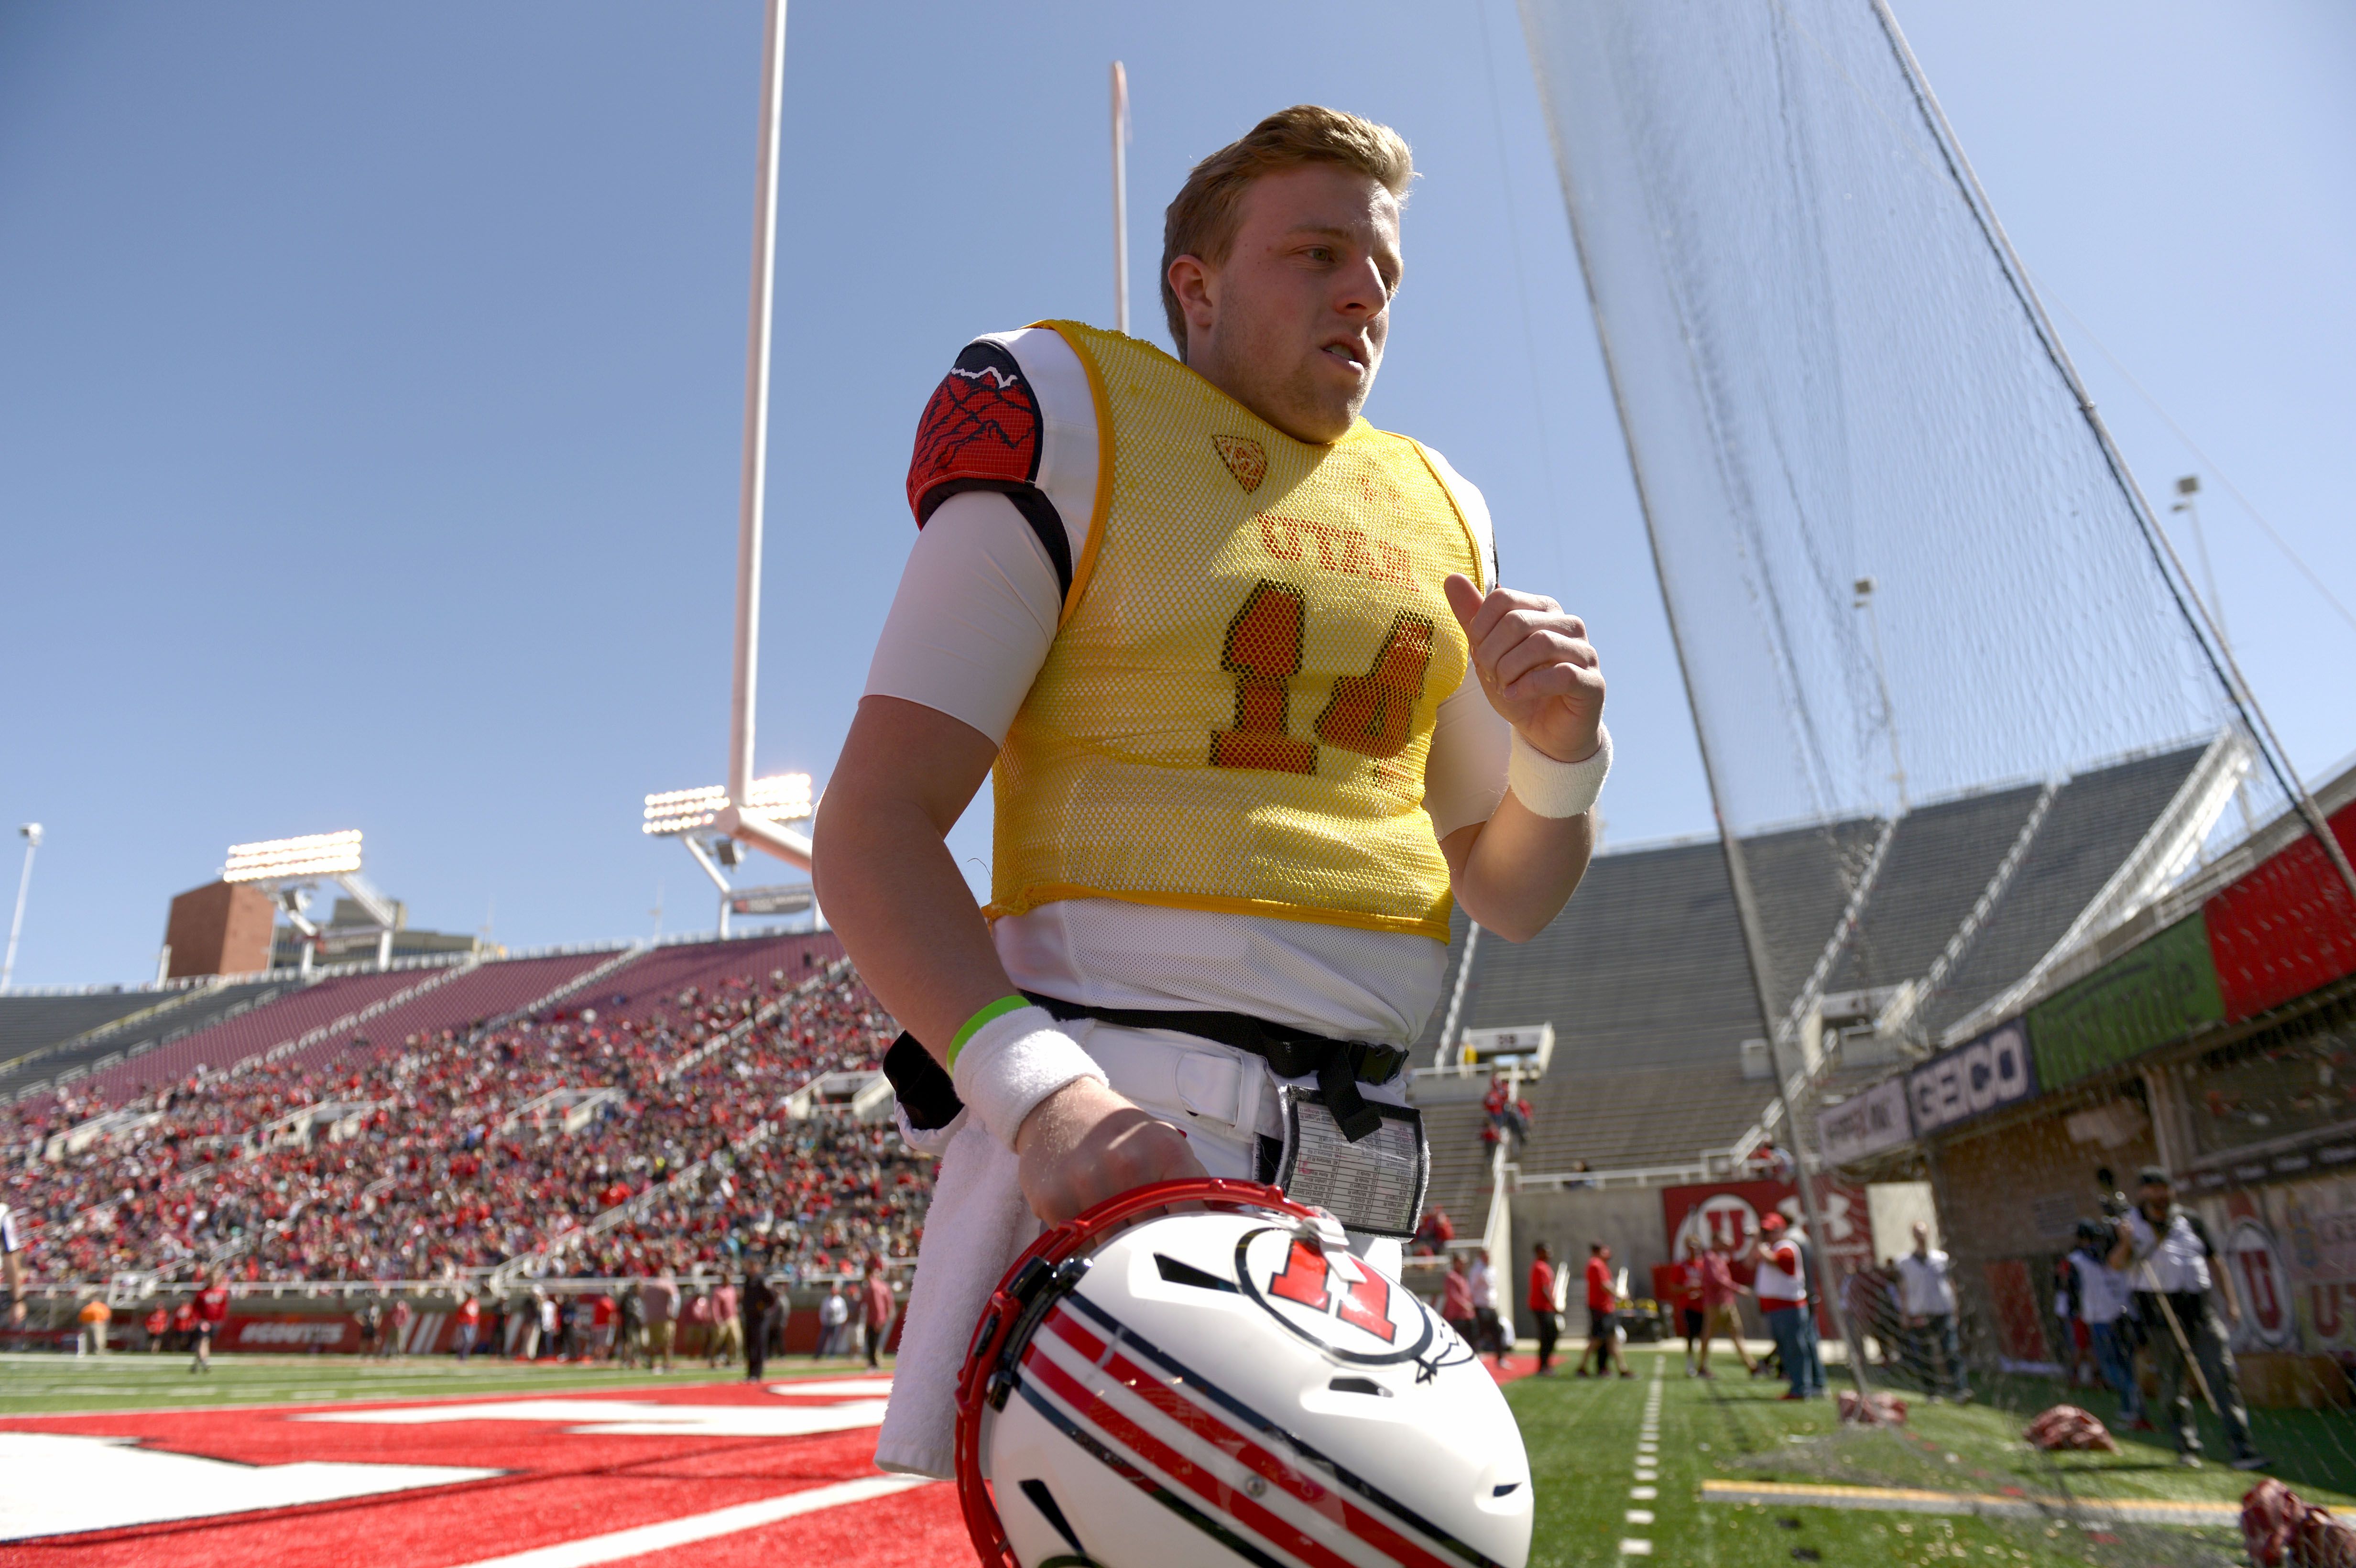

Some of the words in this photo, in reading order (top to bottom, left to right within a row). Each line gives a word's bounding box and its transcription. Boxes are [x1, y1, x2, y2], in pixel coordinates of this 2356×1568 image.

[1255, 512, 1420, 592] UTAH
[1209, 577, 1434, 797] 14
[1915, 1029, 2029, 1133] GEICO
[2238, 1250, 2283, 1329] U
